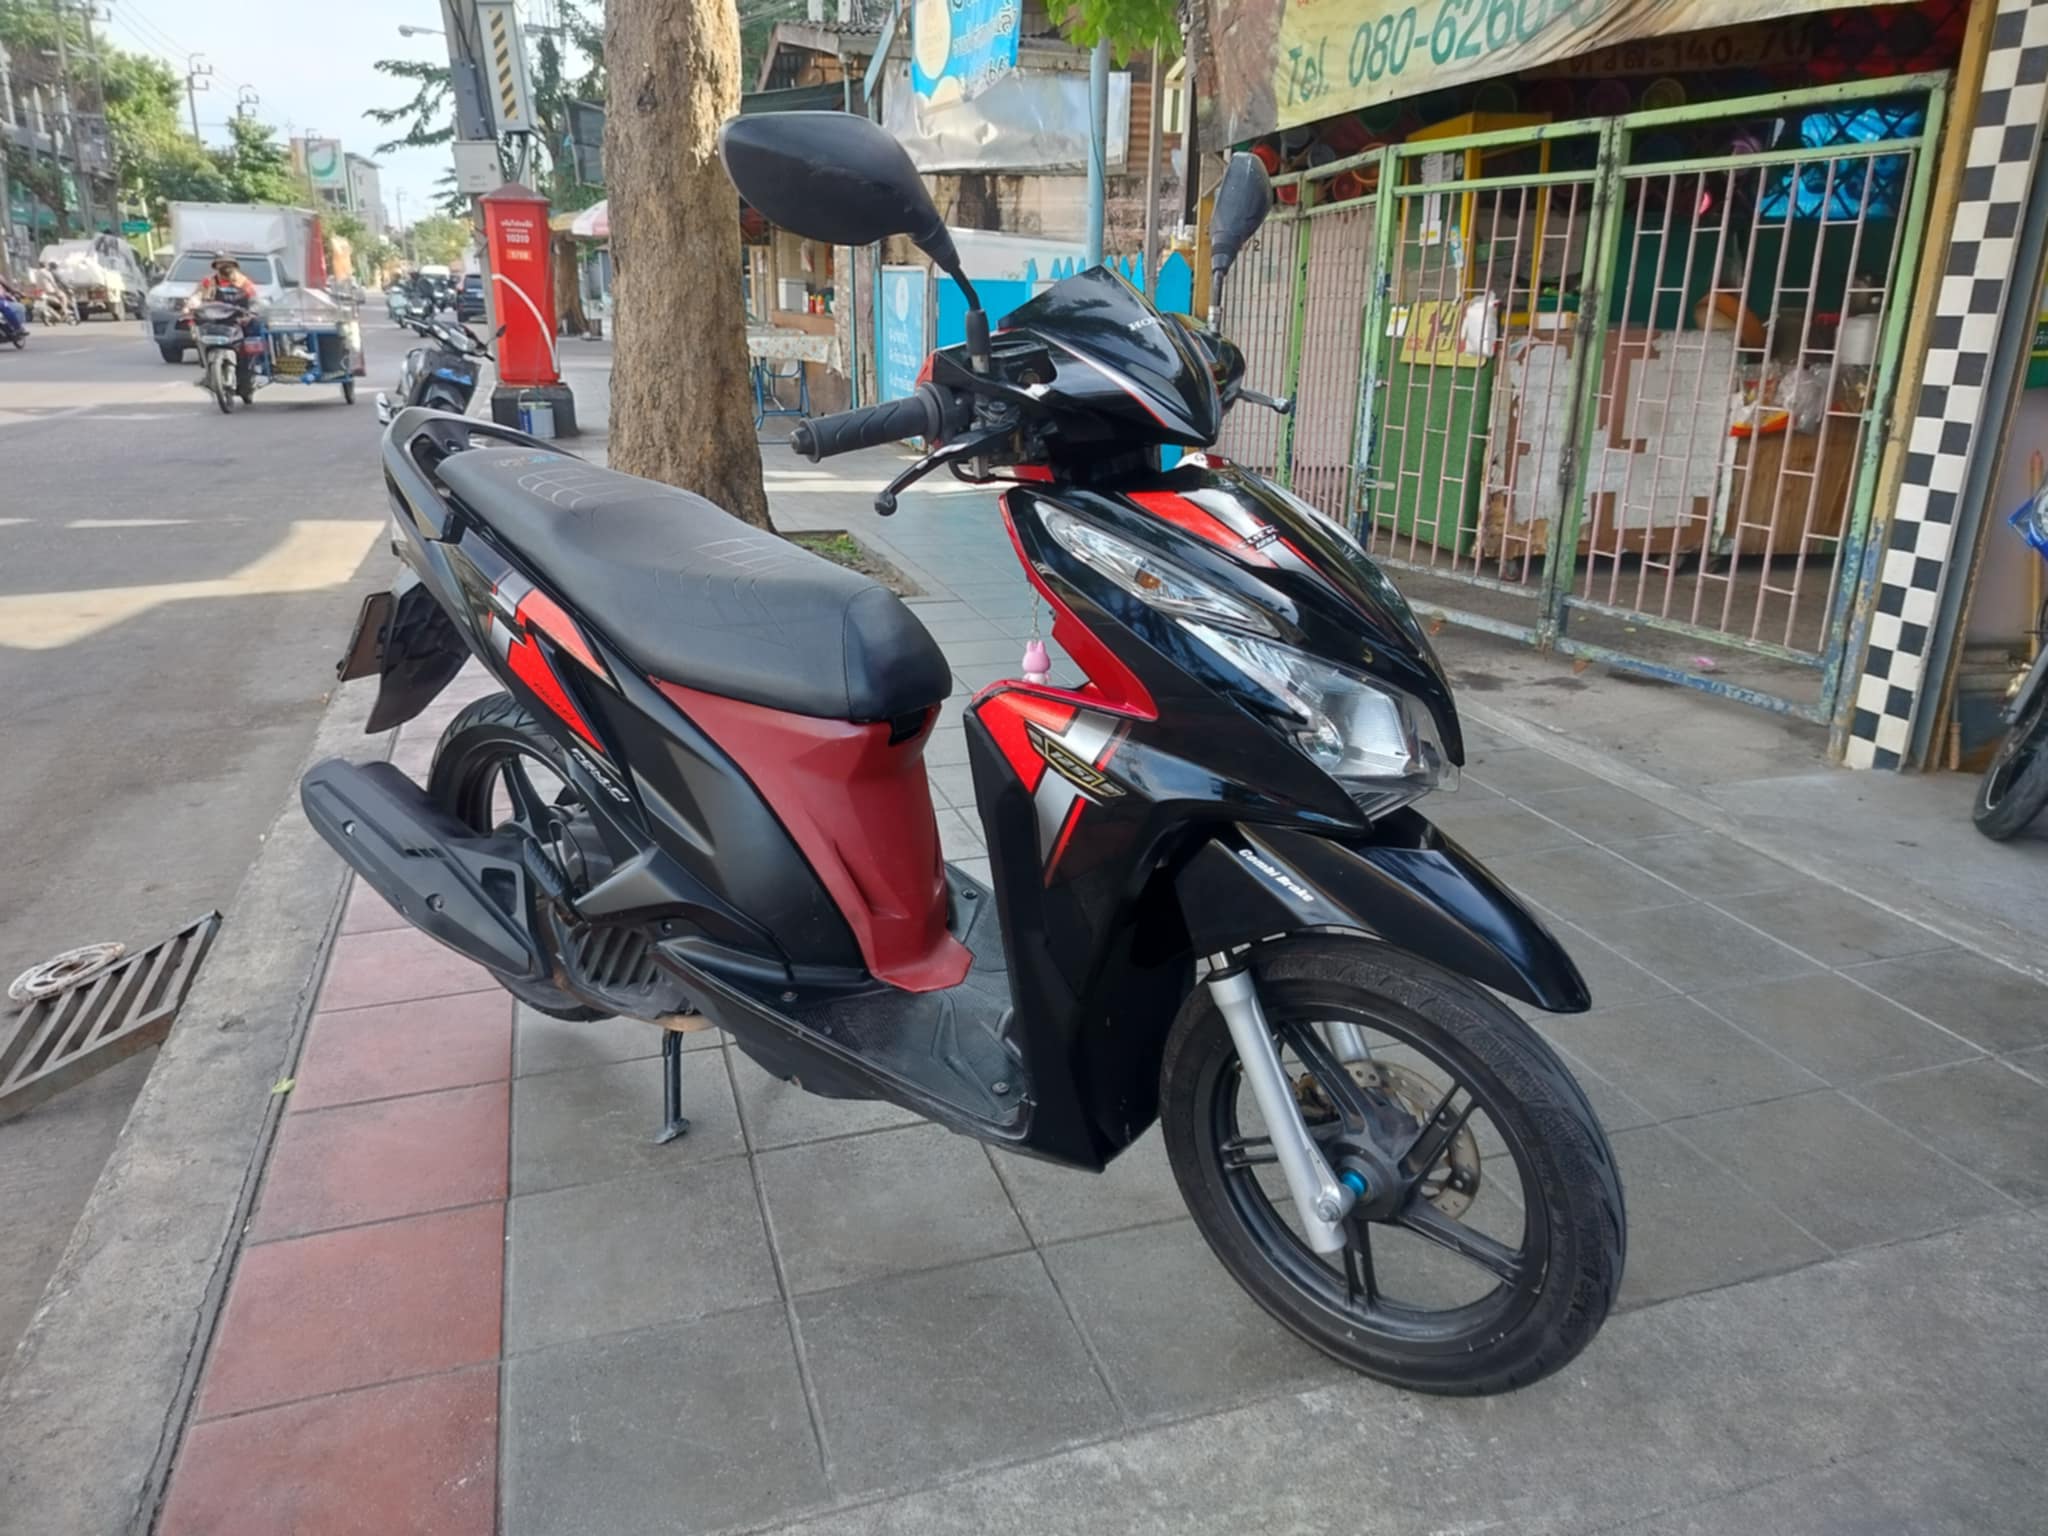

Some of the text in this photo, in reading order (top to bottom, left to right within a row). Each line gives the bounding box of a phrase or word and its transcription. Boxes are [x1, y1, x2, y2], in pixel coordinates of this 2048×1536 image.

[1288, 36, 1329, 106] Tel.
[1238, 848, 1315, 903] Combi Brake
